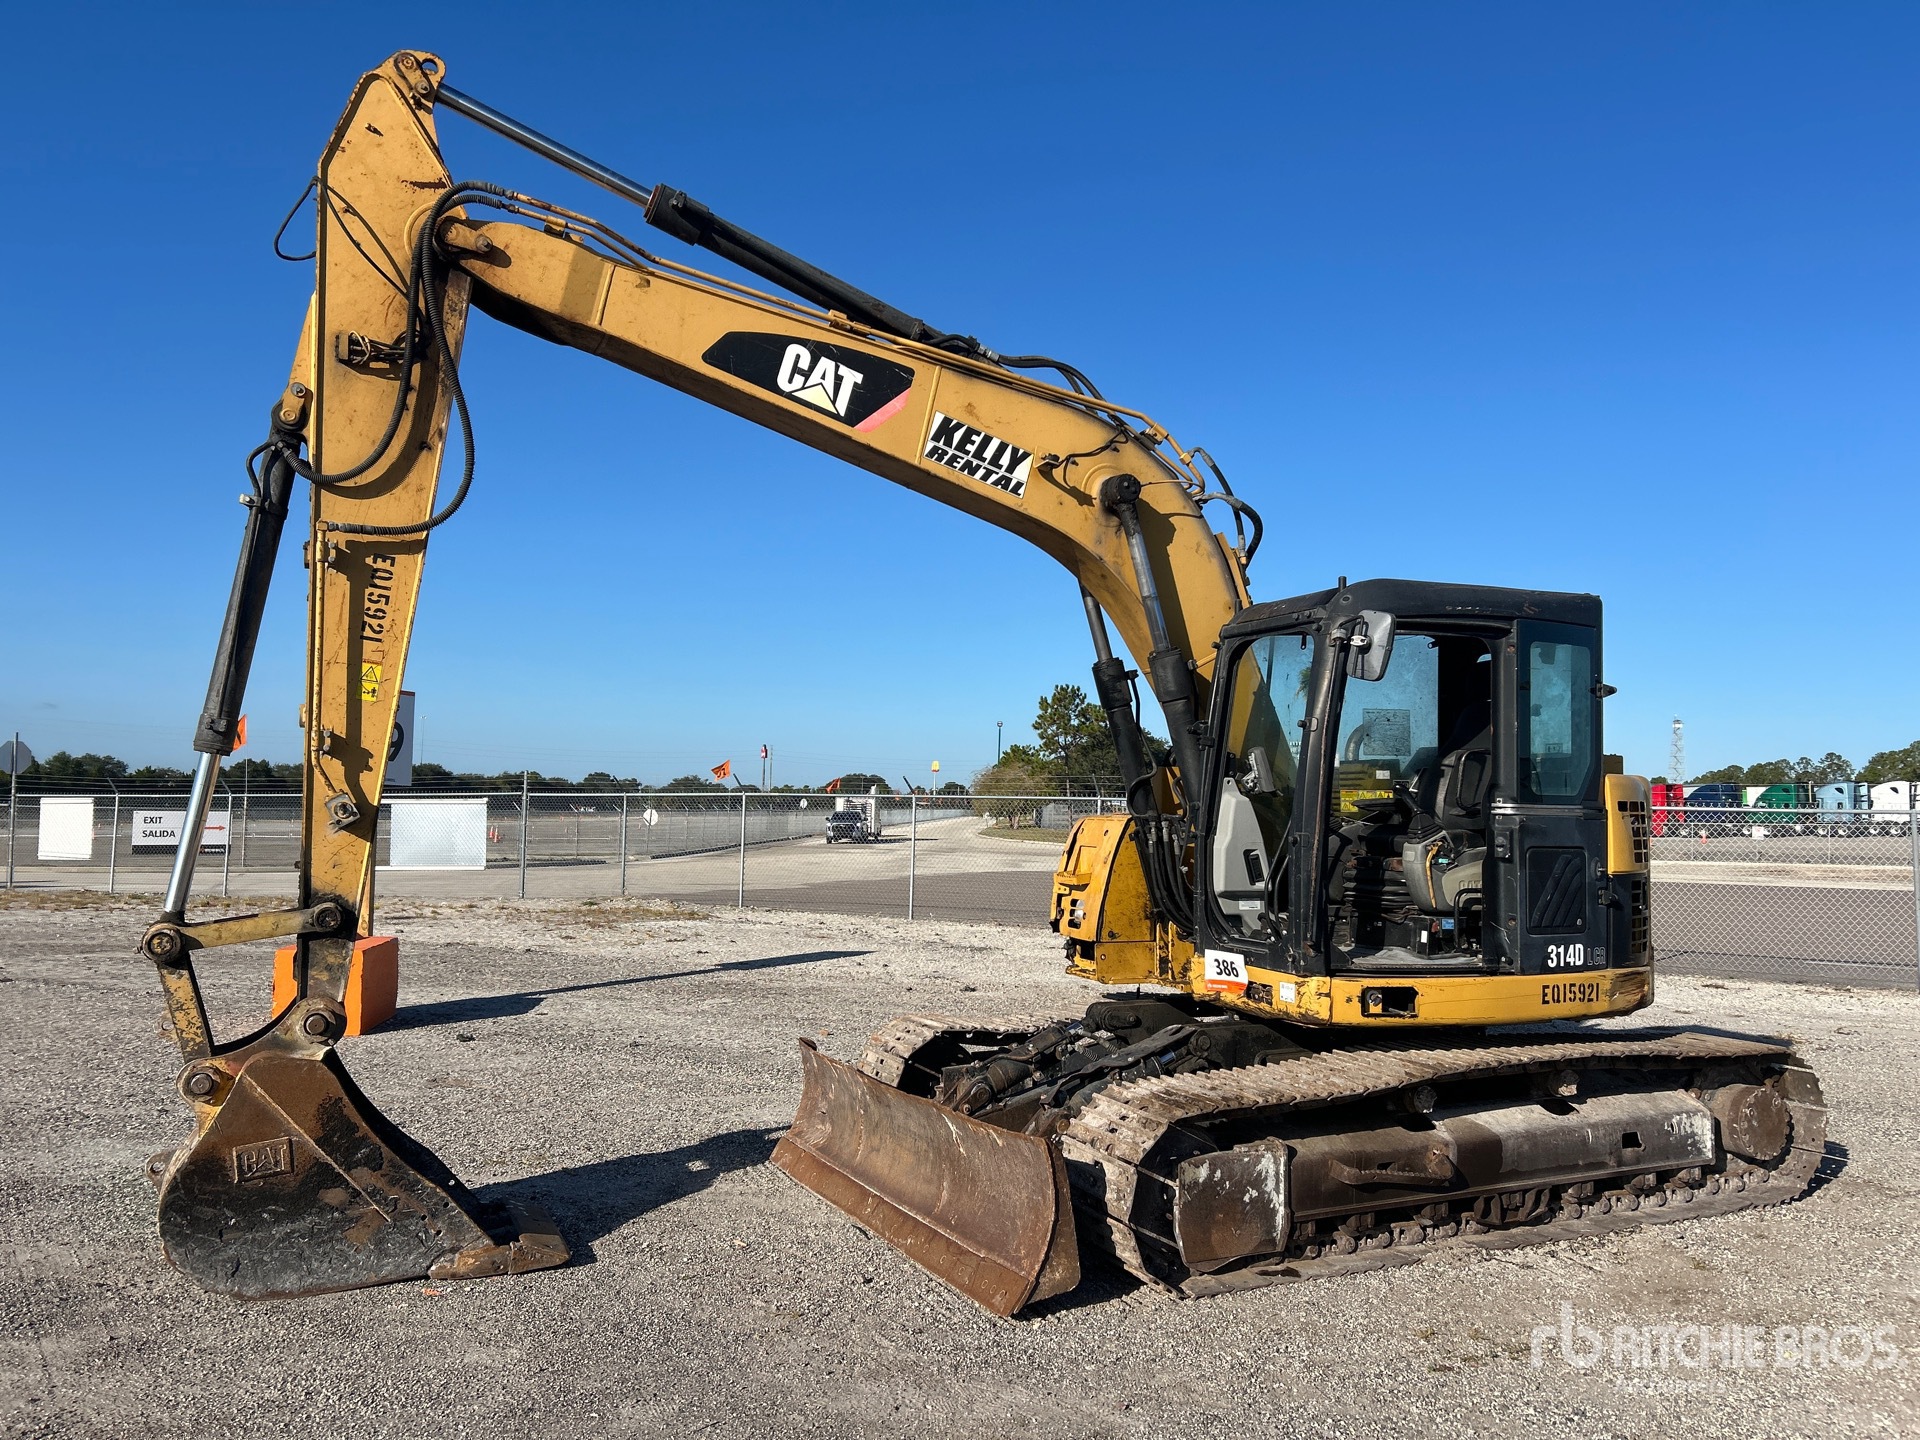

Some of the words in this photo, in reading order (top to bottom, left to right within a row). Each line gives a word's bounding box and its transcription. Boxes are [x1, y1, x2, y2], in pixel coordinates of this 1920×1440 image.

[776, 343, 864, 417] CAT
[930, 415, 1032, 475] KELLY
[926, 444, 1025, 497] RENTAL
[143, 816, 163, 824] EXIT
[142, 830, 176, 838] SALIDA
[1213, 958, 1240, 978] 386
[1547, 943, 1584, 968] 314D
[1541, 982, 1600, 1005] EQ15921
[240, 1144, 287, 1177] CAT
